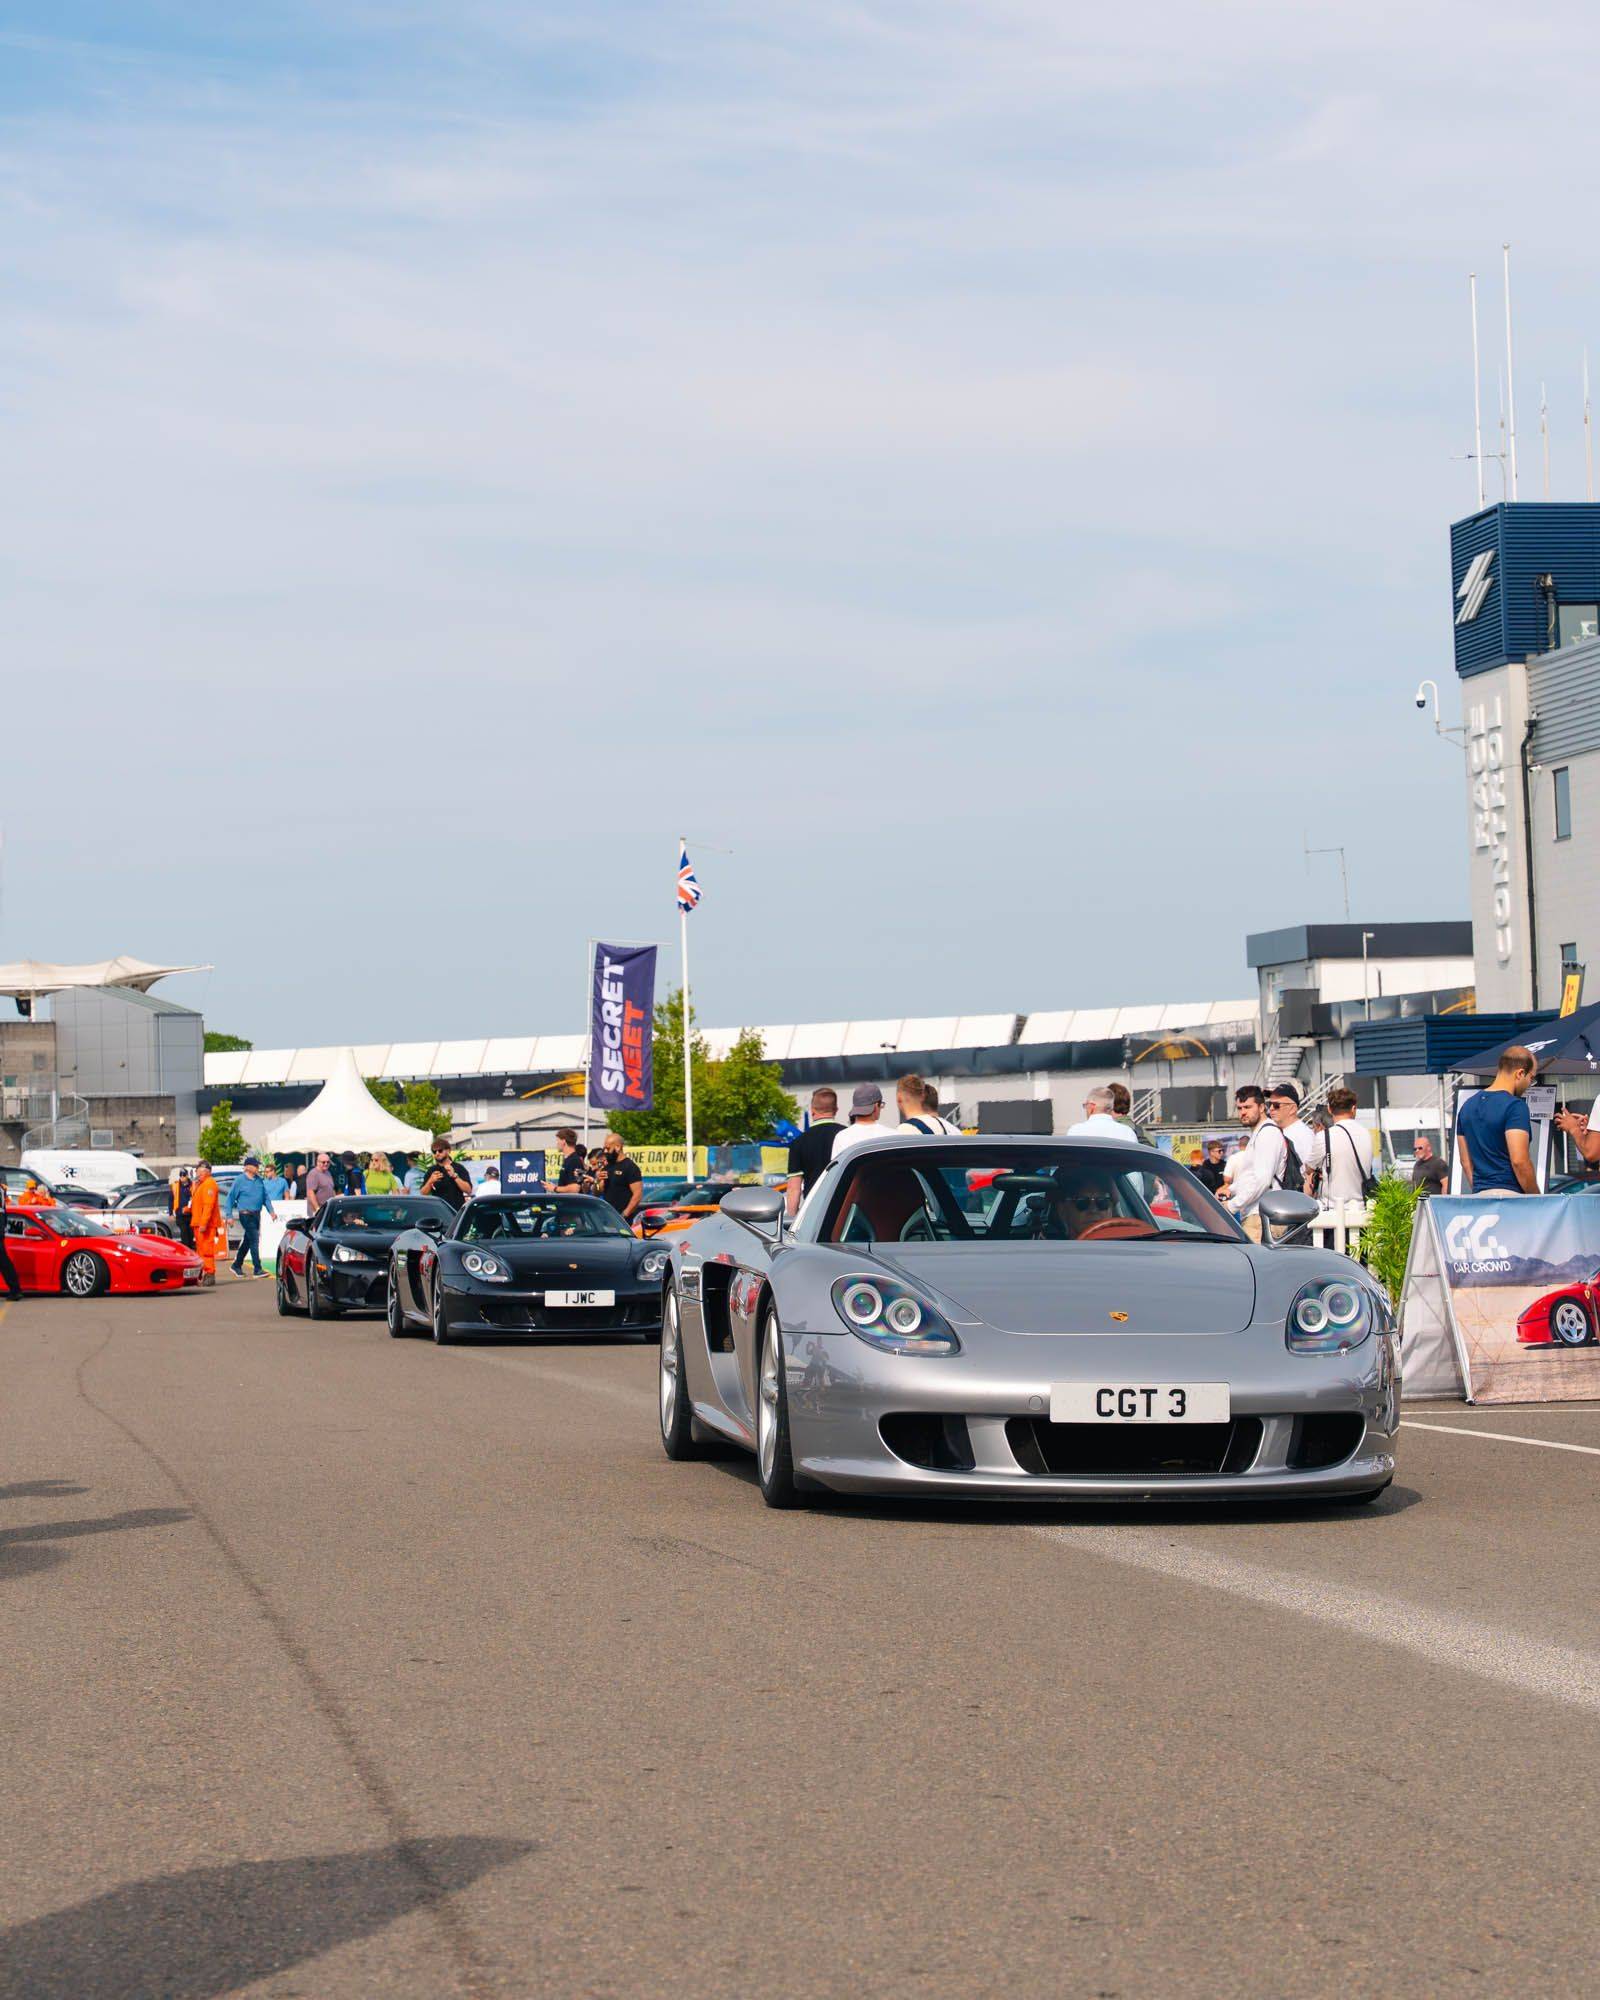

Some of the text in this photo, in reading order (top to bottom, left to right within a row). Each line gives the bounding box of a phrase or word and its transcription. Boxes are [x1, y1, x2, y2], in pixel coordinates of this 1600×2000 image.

[1470, 703, 1490, 849] RACE
[1488, 696, 1512, 962] CONTROL
[600, 956, 625, 1094] SECRET
[623, 1000, 645, 1100] MEET
[648, 1151, 668, 1163] DAY
[672, 1151, 697, 1163] ONY
[507, 1173, 526, 1183] SIGN
[1453, 1262, 1471, 1273] CAR
[572, 1292, 595, 1304] JWC
[1096, 1388, 1186, 1417] CGT 3
